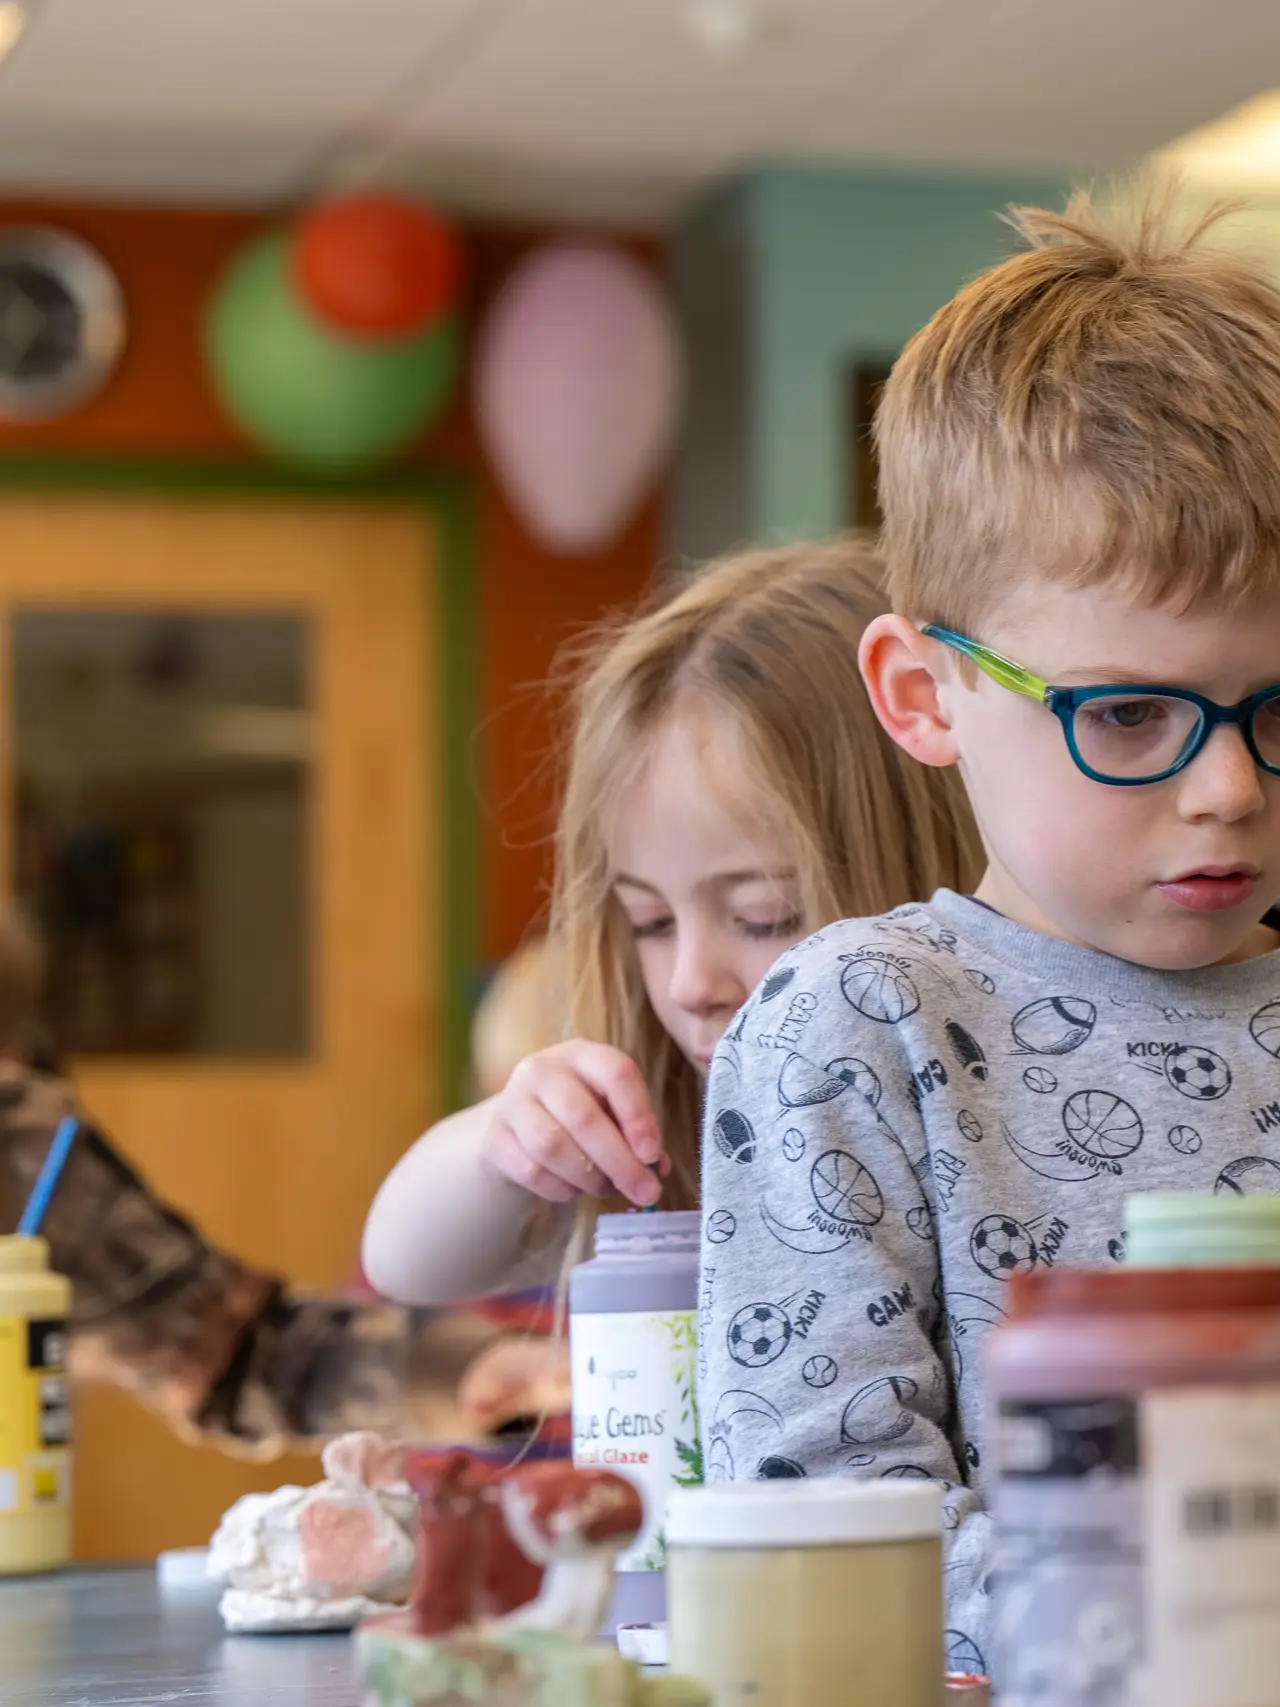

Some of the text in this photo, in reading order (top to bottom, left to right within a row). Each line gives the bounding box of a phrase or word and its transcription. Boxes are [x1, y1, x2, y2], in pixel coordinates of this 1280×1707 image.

[1040, 1215, 1070, 1268] KICK!
[794, 1289, 826, 1340] KICK!
[606, 1407, 664, 1438] Gems
[603, 1448, 649, 1464] Glaze
